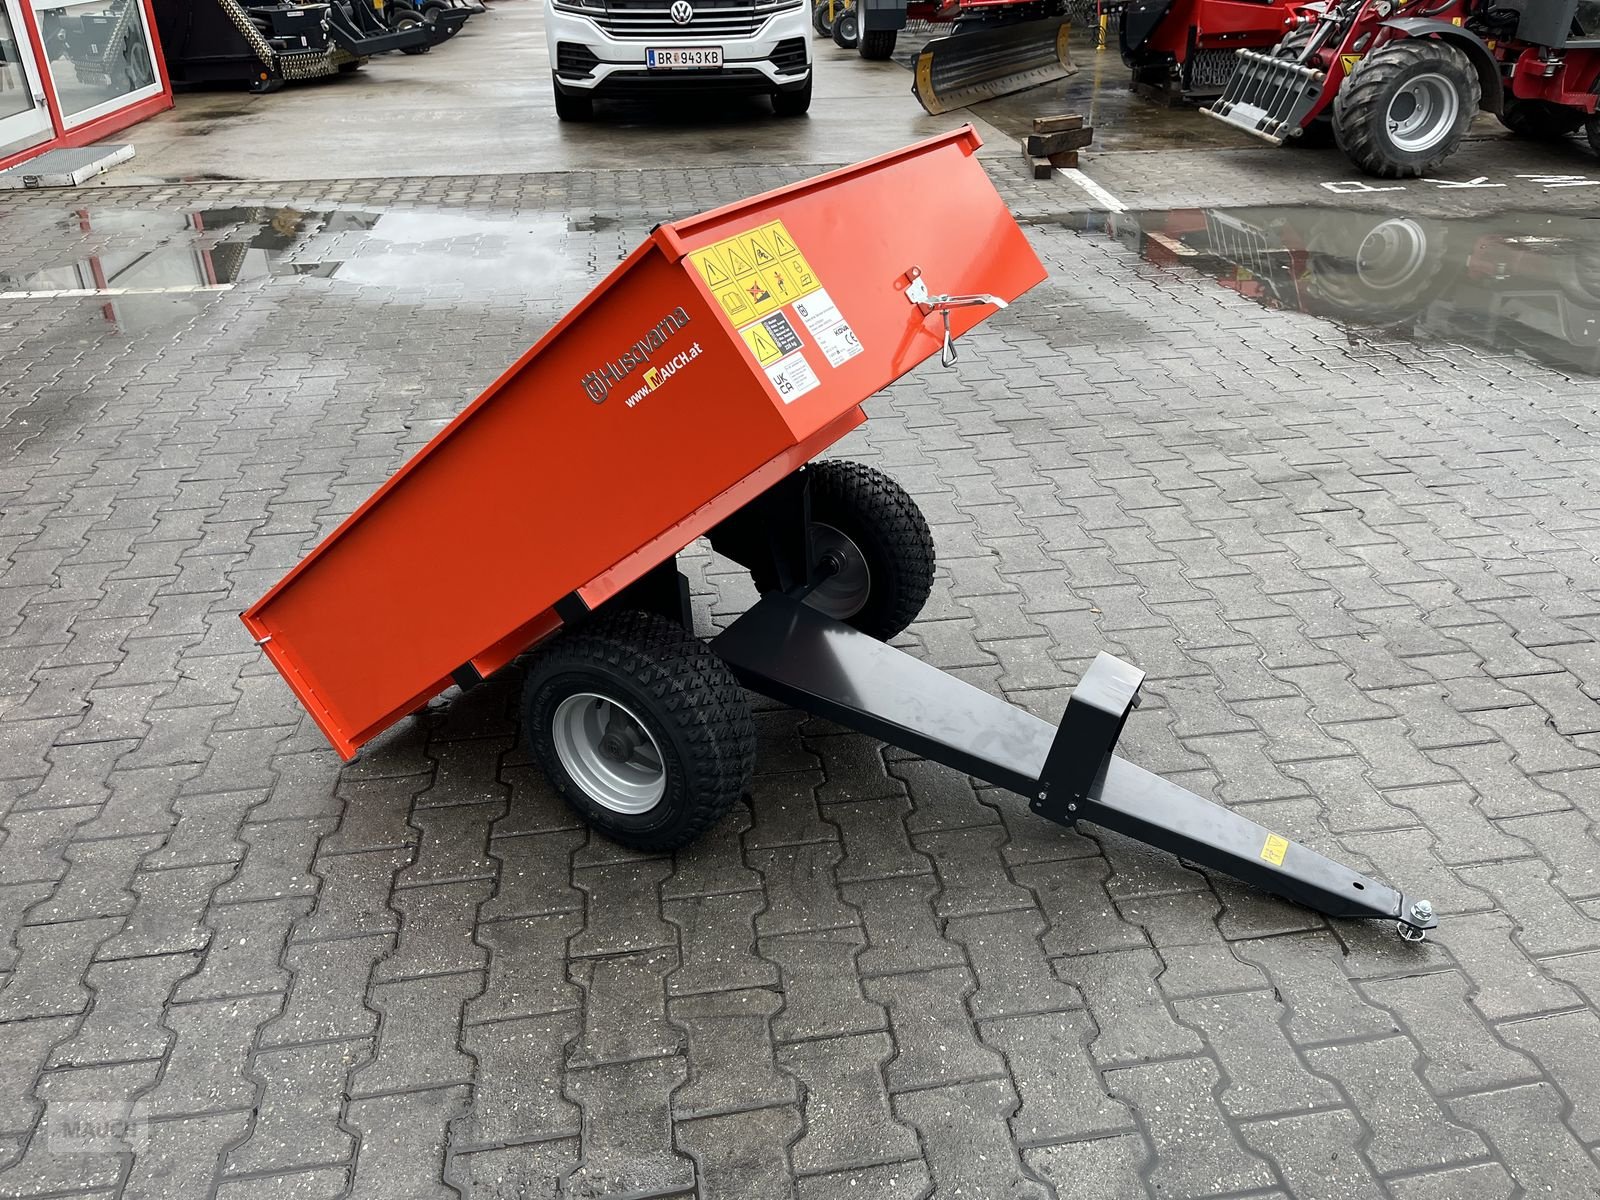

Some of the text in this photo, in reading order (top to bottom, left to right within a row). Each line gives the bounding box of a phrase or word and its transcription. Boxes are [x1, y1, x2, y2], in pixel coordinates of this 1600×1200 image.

[658, 51, 719, 65] BR 943 KB
[599, 306, 691, 388] Husqvarna
[625, 342, 703, 408] www.MAUCH.at
[772, 372, 788, 386] UK
[780, 382, 795, 394] CA
